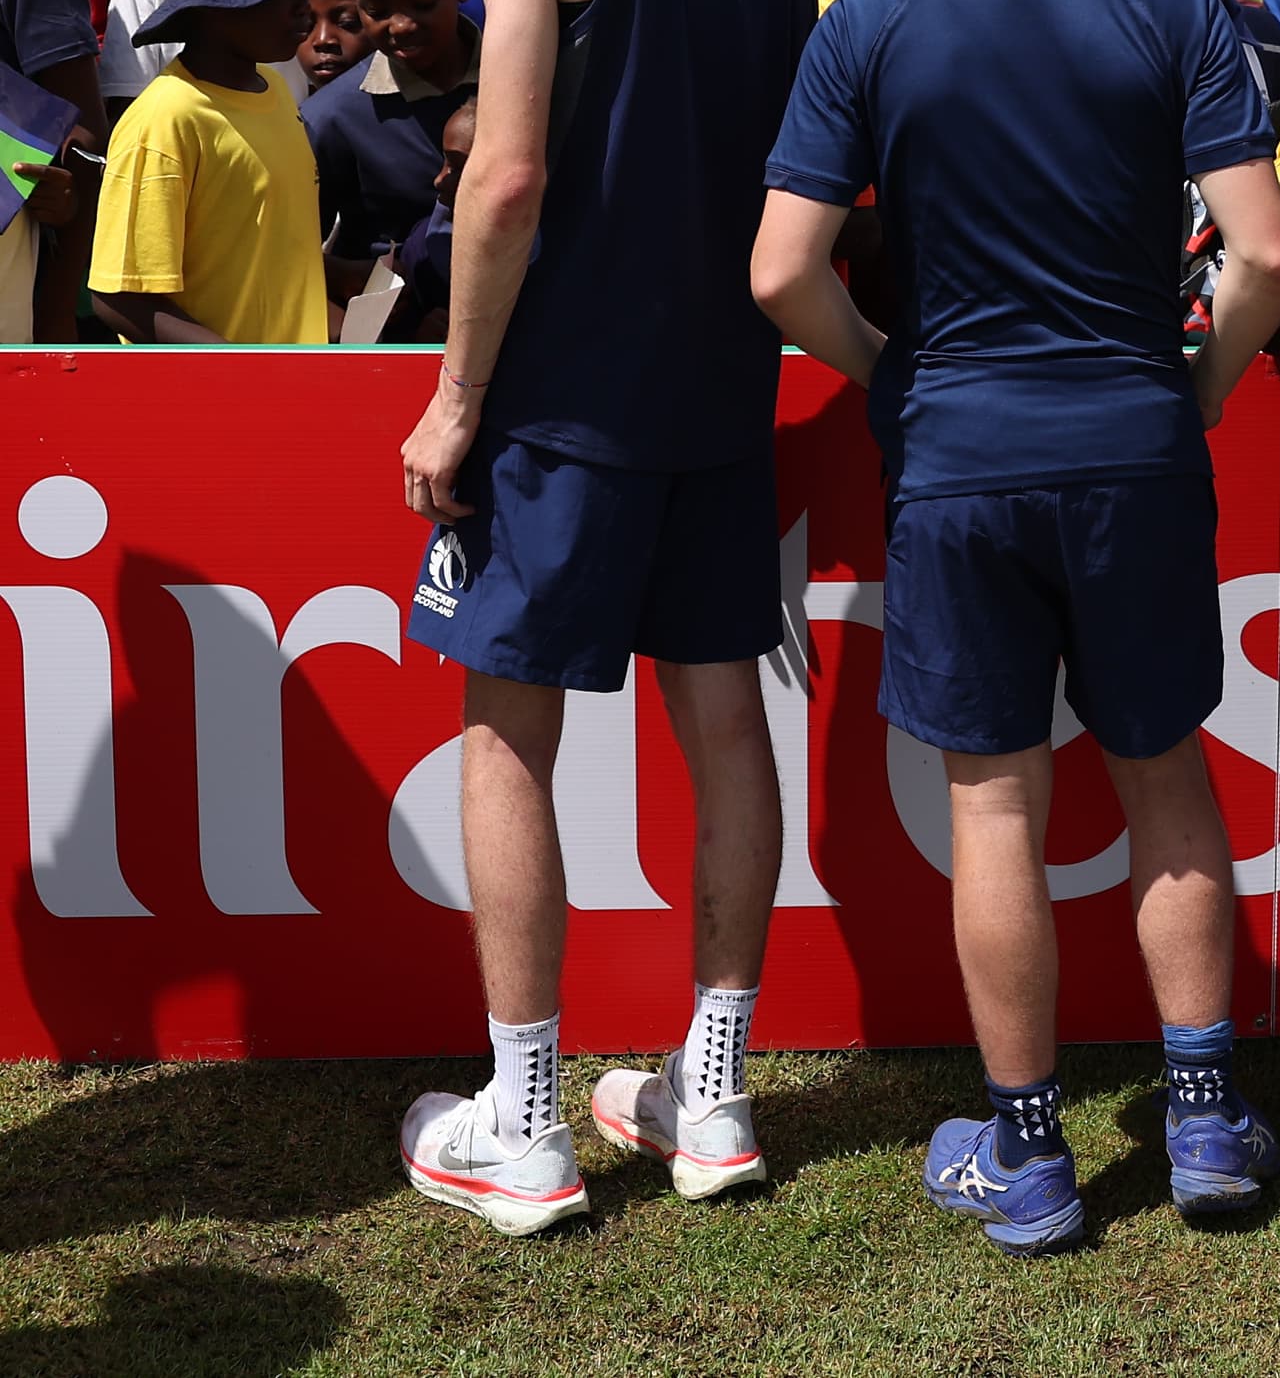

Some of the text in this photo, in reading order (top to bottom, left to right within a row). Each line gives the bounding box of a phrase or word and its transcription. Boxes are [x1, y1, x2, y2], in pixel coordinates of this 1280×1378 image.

[413, 593, 455, 618] SCOTLAND
[418, 584, 458, 610] CRICKET
[516, 1025, 548, 1038] GAIN
